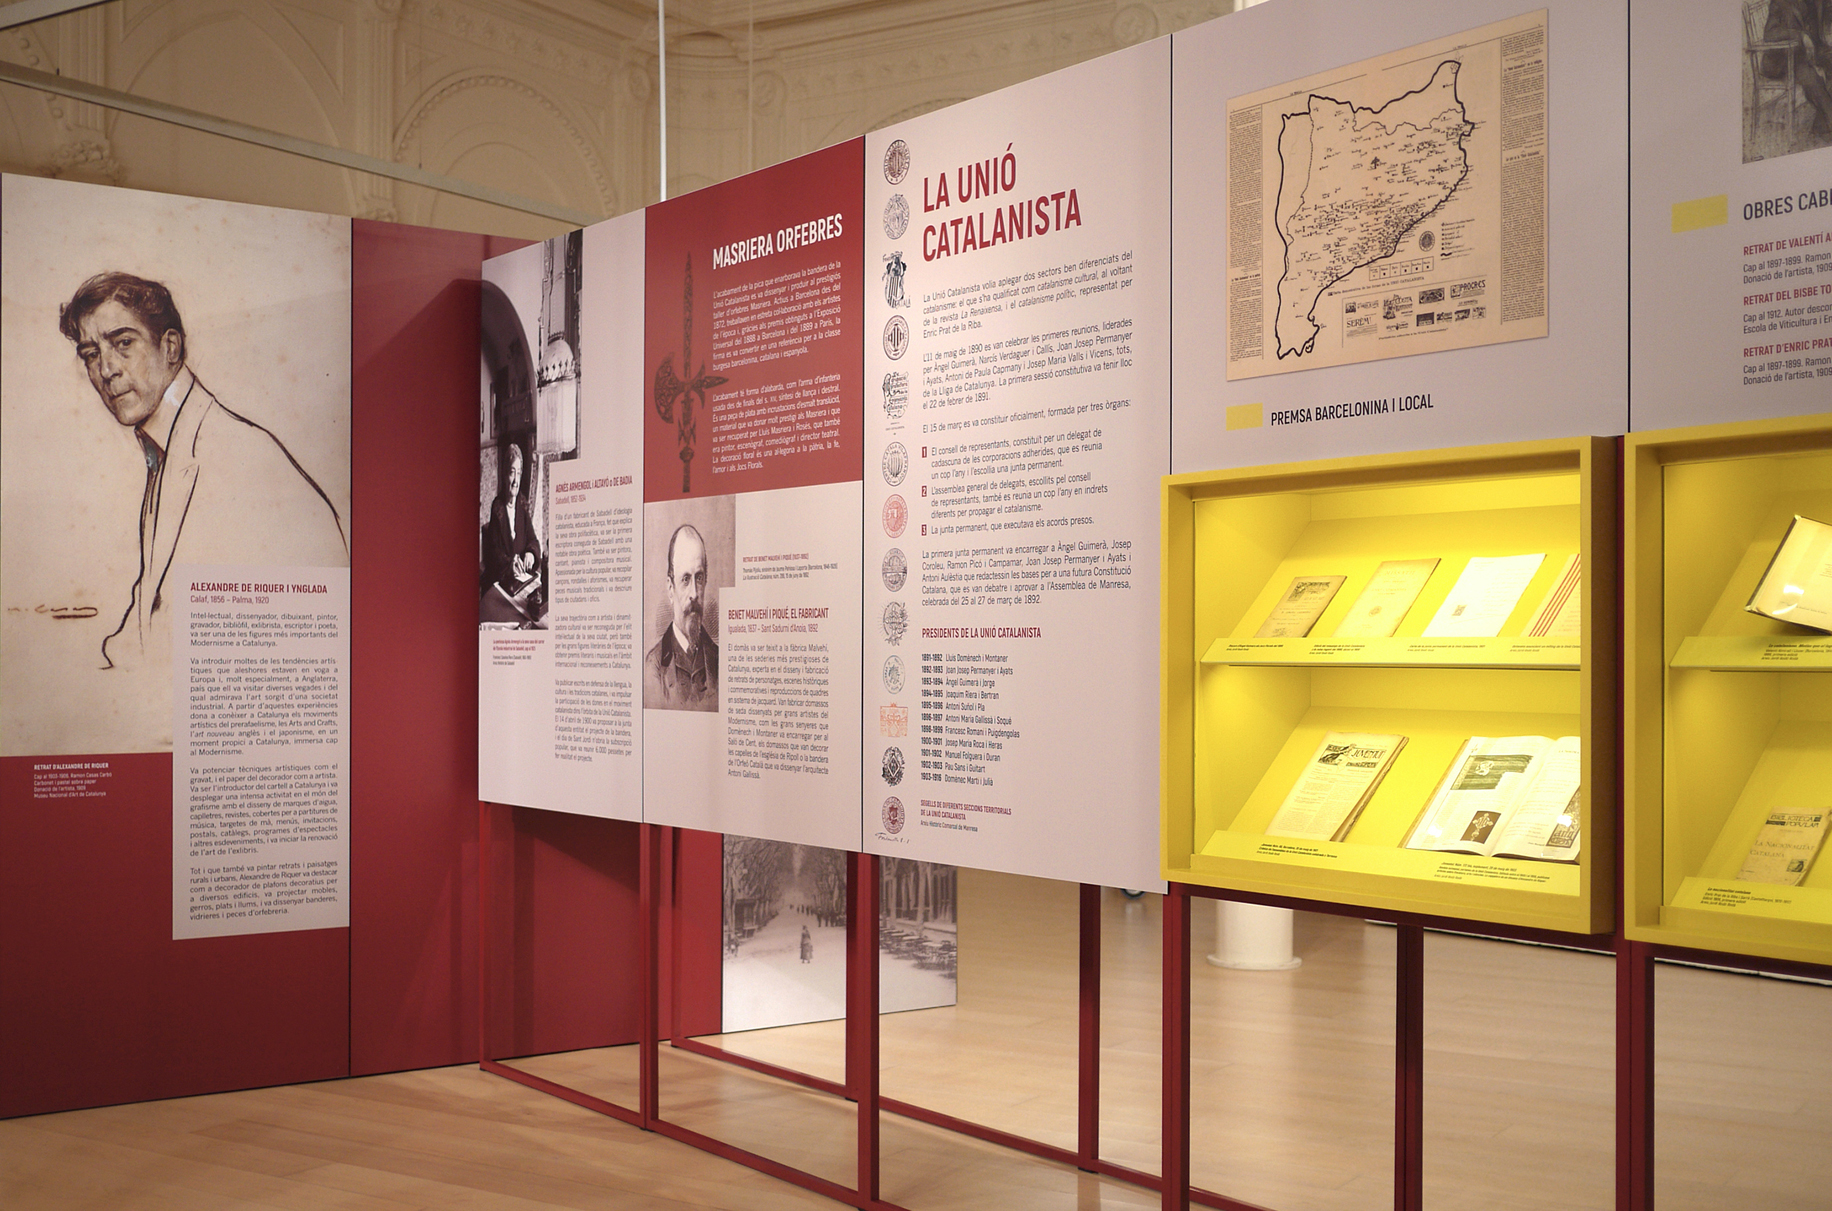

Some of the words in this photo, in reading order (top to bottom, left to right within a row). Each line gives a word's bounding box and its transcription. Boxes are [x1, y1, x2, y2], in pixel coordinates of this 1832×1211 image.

[923, 172, 950, 213] LA
[958, 143, 1016, 203] UNIÓ
[1744, 195, 1793, 220] OBRES
[1799, 188, 1832, 211] CAB
[923, 189, 1082, 262] CATALANISTA
[713, 233, 773, 269] MASRIERA
[778, 213, 842, 253] ORFEBRES
[1744, 242, 1773, 255] RETRAT
[1776, 240, 1786, 250] DE
[1789, 232, 1823, 248] VALENTÍ
[1743, 264, 1756, 273] Cap
[1759, 261, 1765, 270] al
[1767, 256, 1803, 269] 1897-1899.
[1805, 253, 1831, 263] Ramon
[924, 293, 930, 303] La
[933, 290, 945, 301] Unió
[948, 283, 980, 298] Catalanista
[982, 280, 996, 290] volia
[998, 276, 1021, 289] aplegar
[1024, 272, 1035, 282] dos
[1038, 267, 1061, 279] sectors
[1064, 264, 1076, 273] ben
[1079, 254, 1119, 270] diferenciats
[1122, 250, 1132, 262] del
[1744, 271, 1772, 284] Donació
[1774, 270, 1782, 279] de
[1744, 293, 1773, 306] RETRAT
[1776, 290, 1791, 301] DEL
[1794, 286, 1818, 299] BISBE
[1743, 314, 1756, 323] Cap
[1759, 312, 1765, 320] al
[1767, 310, 1782, 319] 1912.
[1785, 307, 1804, 317] Autor
[1744, 324, 1766, 334] Escola
[1769, 322, 1777, 330] de
[1780, 318, 1817, 329] Viticultura
[1820, 316, 1822, 324] i
[1744, 345, 1773, 357] RETRAT
[1776, 340, 1809, 353] D'ENRIC
[1743, 365, 1756, 374] Cap
[1759, 363, 1765, 371] al
[1767, 359, 1803, 370] 1897-1899.
[1805, 358, 1831, 366] Ramon
[1744, 374, 1772, 385] Donació
[1774, 373, 1782, 381] de
[923, 424, 928, 433] El
[930, 423, 937, 432] 15
[939, 422, 945, 431] de
[948, 422, 962, 430] març
[981, 414, 1008, 425] constituir
[1010, 409, 1046, 421] oficialment,
[1048, 405, 1075, 416] formada
[1077, 405, 1088, 414] per
[1091, 402, 1103, 410] tres
[1106, 400, 1131, 409] òrgans:
[1271, 407, 1312, 426] PREMSA
[1316, 398, 1389, 421] BARCELONINA
[1392, 397, 1395, 412] I
[1399, 393, 1433, 411] LOCAL
[614, 477, 619, 486] DE
[931, 525, 938, 534] La
[940, 524, 954, 535] junta
[956, 522, 988, 534] permanent,
[991, 523, 1002, 532] que
[1004, 519, 1033, 529] executava
[1036, 517, 1044, 527] els
[1047, 516, 1068, 526] acords
[1071, 516, 1094, 526] presos.
[191, 583, 239, 592] ALEXANDRE
[242, 584, 251, 592] DE
[254, 584, 284, 593] RIQUER
[287, 584, 290, 593] I
[292, 584, 327, 593] YNGLADA
[191, 595, 209, 604] Calaf,
[232, 596, 253, 604] Palma,
[236, 613, 278, 621] dissenyador,
[728, 610, 745, 620] BENET
[746, 607, 768, 619] MALVEHÍ
[769, 609, 772, 619] I
[772, 607, 789, 620] PIQUÉ,
[791, 609, 797, 619] EL
[799, 608, 829, 619] FABRICANT
[922, 628, 959, 638] PRESIDENTS
[961, 628, 969, 638] DE
[970, 628, 979, 638] LA
[980, 626, 996, 638] UNIÓ
[998, 627, 1041, 638] CATALANISTA
[242, 640, 277, 648] Catalunya.
